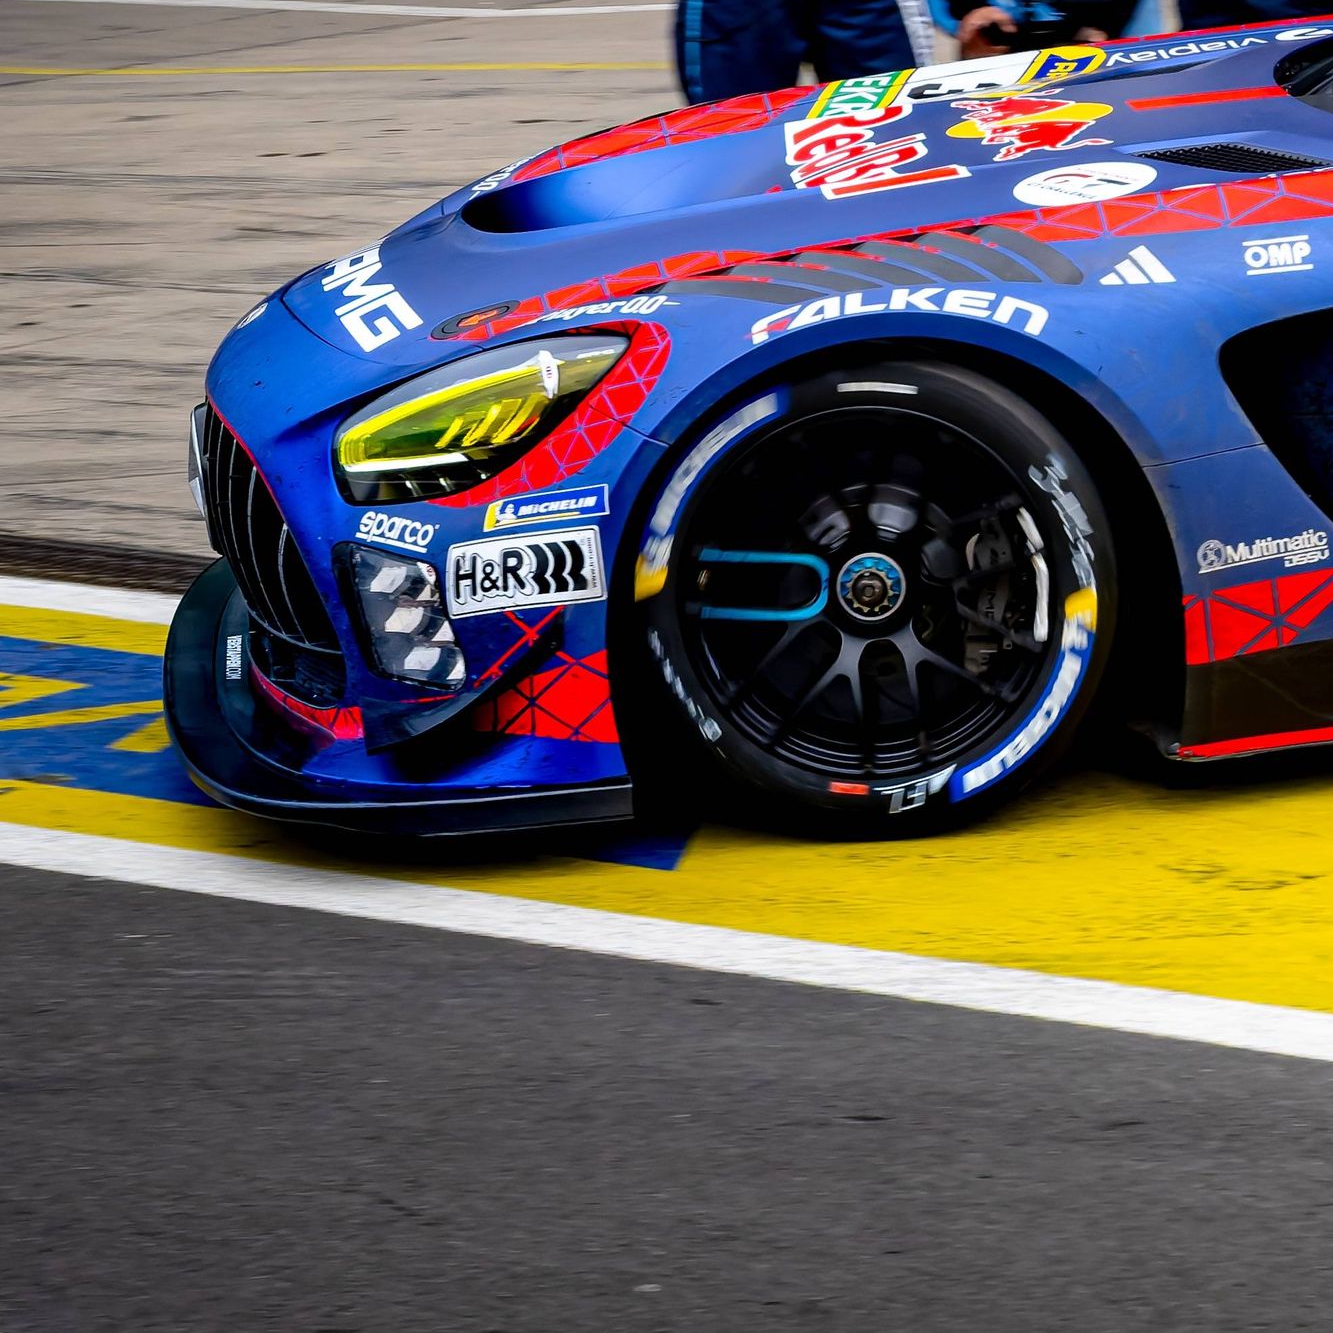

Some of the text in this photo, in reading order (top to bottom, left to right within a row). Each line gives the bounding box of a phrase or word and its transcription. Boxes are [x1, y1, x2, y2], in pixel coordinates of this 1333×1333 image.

[1106, 37, 1268, 67] viaplay
[1243, 241, 1312, 270] OMP
[321, 244, 424, 354] AMG
[749, 286, 1050, 346] FALKEN
[517, 495, 599, 518] MICHELIN
[357, 511, 436, 549] sparco
[1225, 529, 1328, 563] Multimatic
[453, 547, 532, 605] H&R
[225, 633, 243, 681] VERSTAPPEN.COM
